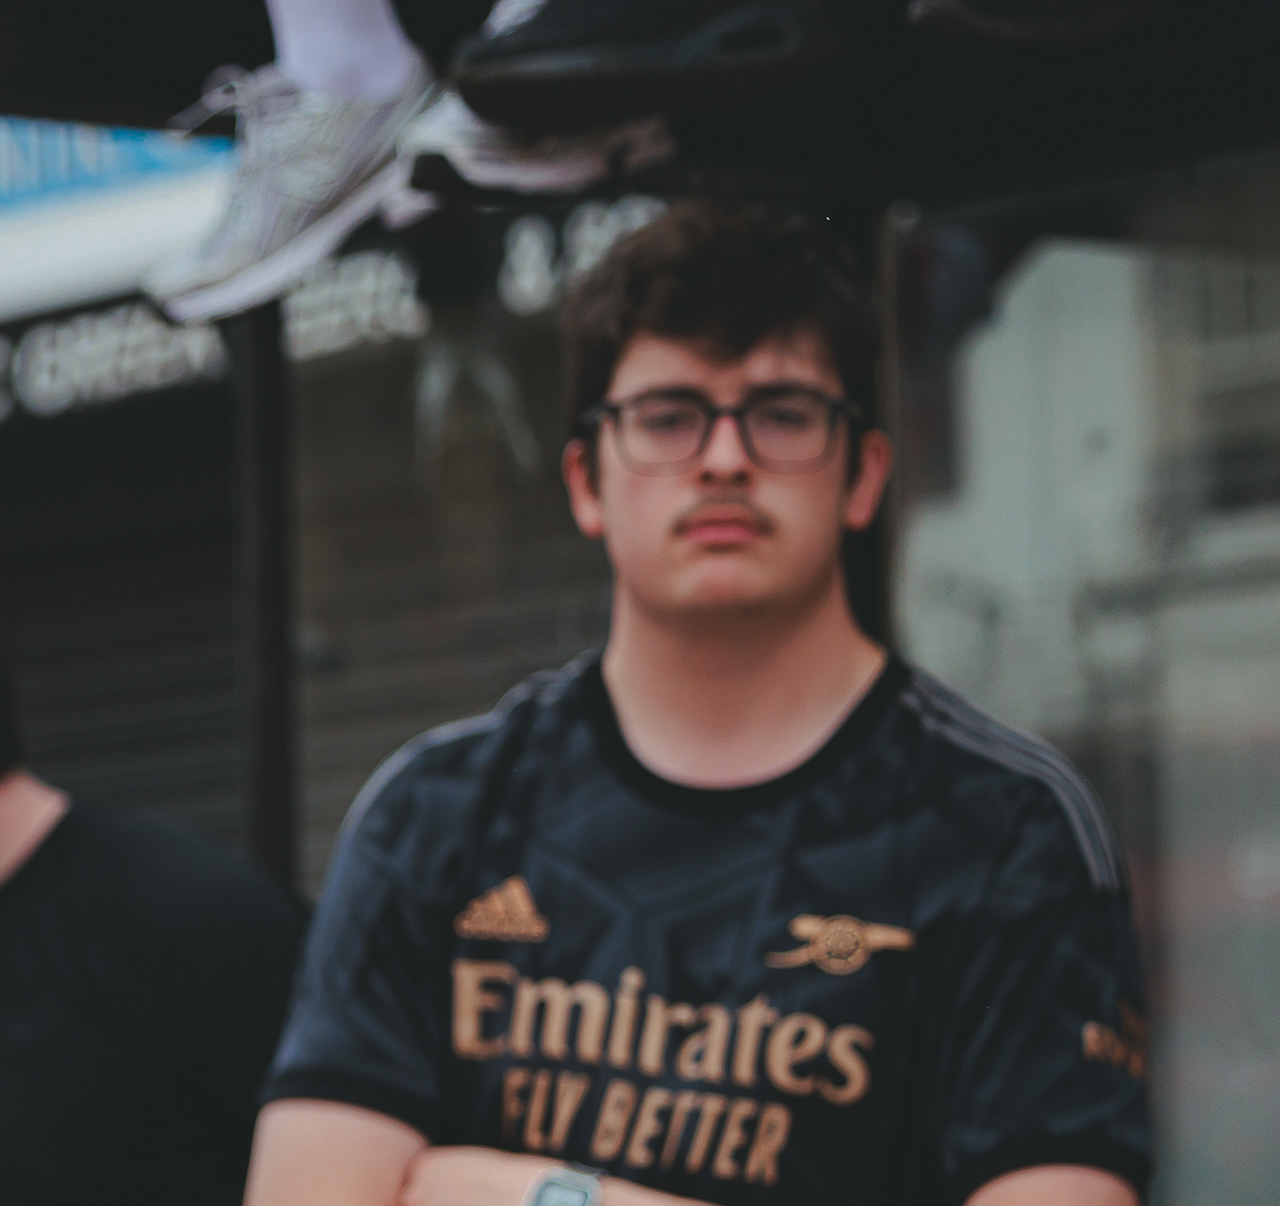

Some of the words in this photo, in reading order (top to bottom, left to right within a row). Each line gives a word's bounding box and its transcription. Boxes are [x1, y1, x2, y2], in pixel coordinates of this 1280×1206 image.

[450, 957, 875, 1107] Emirates
[501, 1065, 590, 1152] FLY
[591, 1076, 793, 1188] BETTER
